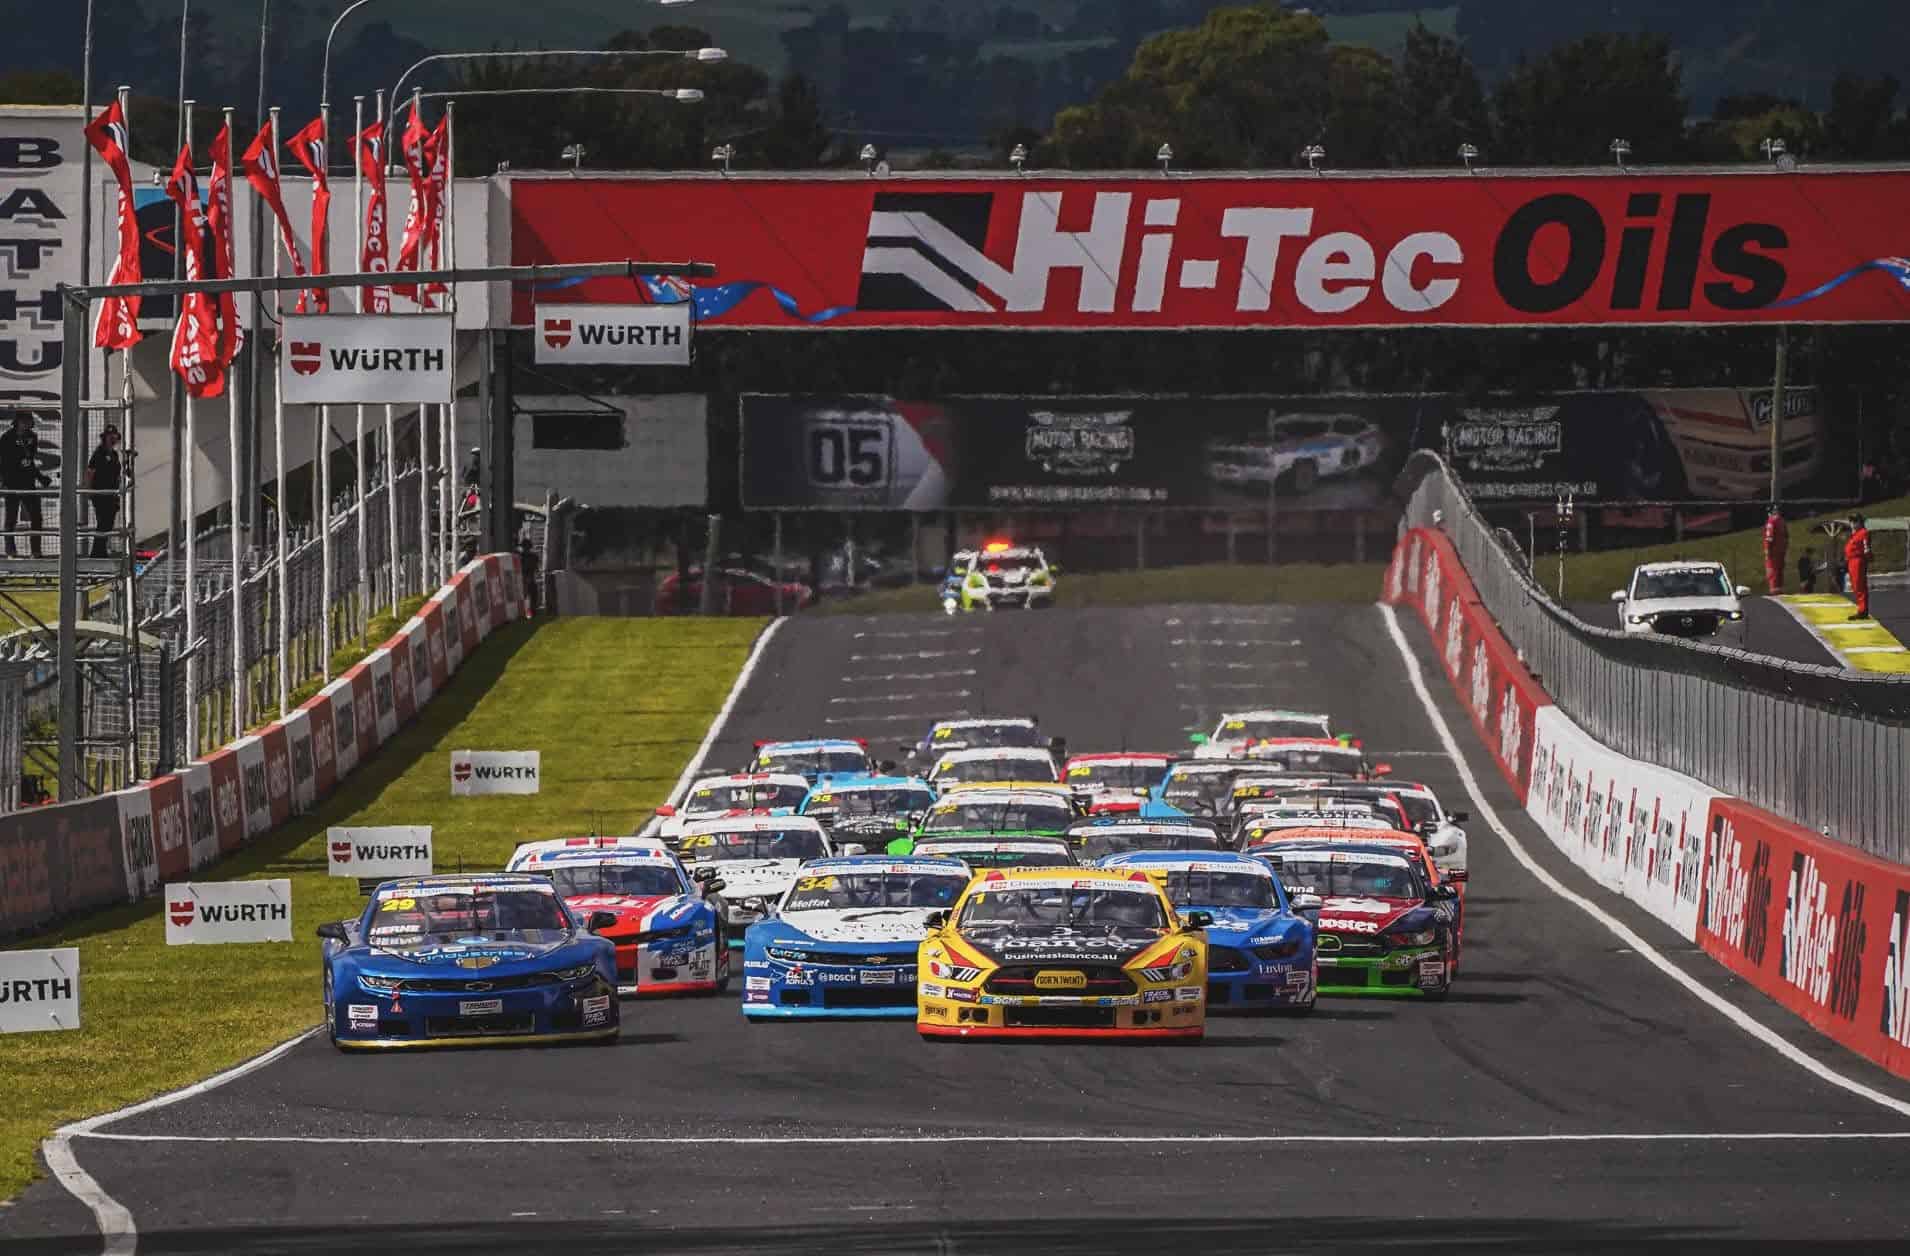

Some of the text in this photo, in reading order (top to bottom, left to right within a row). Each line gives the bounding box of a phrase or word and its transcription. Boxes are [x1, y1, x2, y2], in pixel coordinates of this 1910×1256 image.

[1004, 191, 1790, 315] Hi-Tec Oils
[579, 324, 682, 346] WÜRTH
[330, 348, 444, 372] WÜRTH
[809, 428, 884, 485] 05
[475, 764, 537, 779] WÜRTH
[356, 844, 429, 862] WÜRTH
[798, 876, 833, 891] 34
[199, 902, 287, 923] WÜRTH
[382, 898, 416, 912] 29
[828, 974, 857, 982] BOSCH
